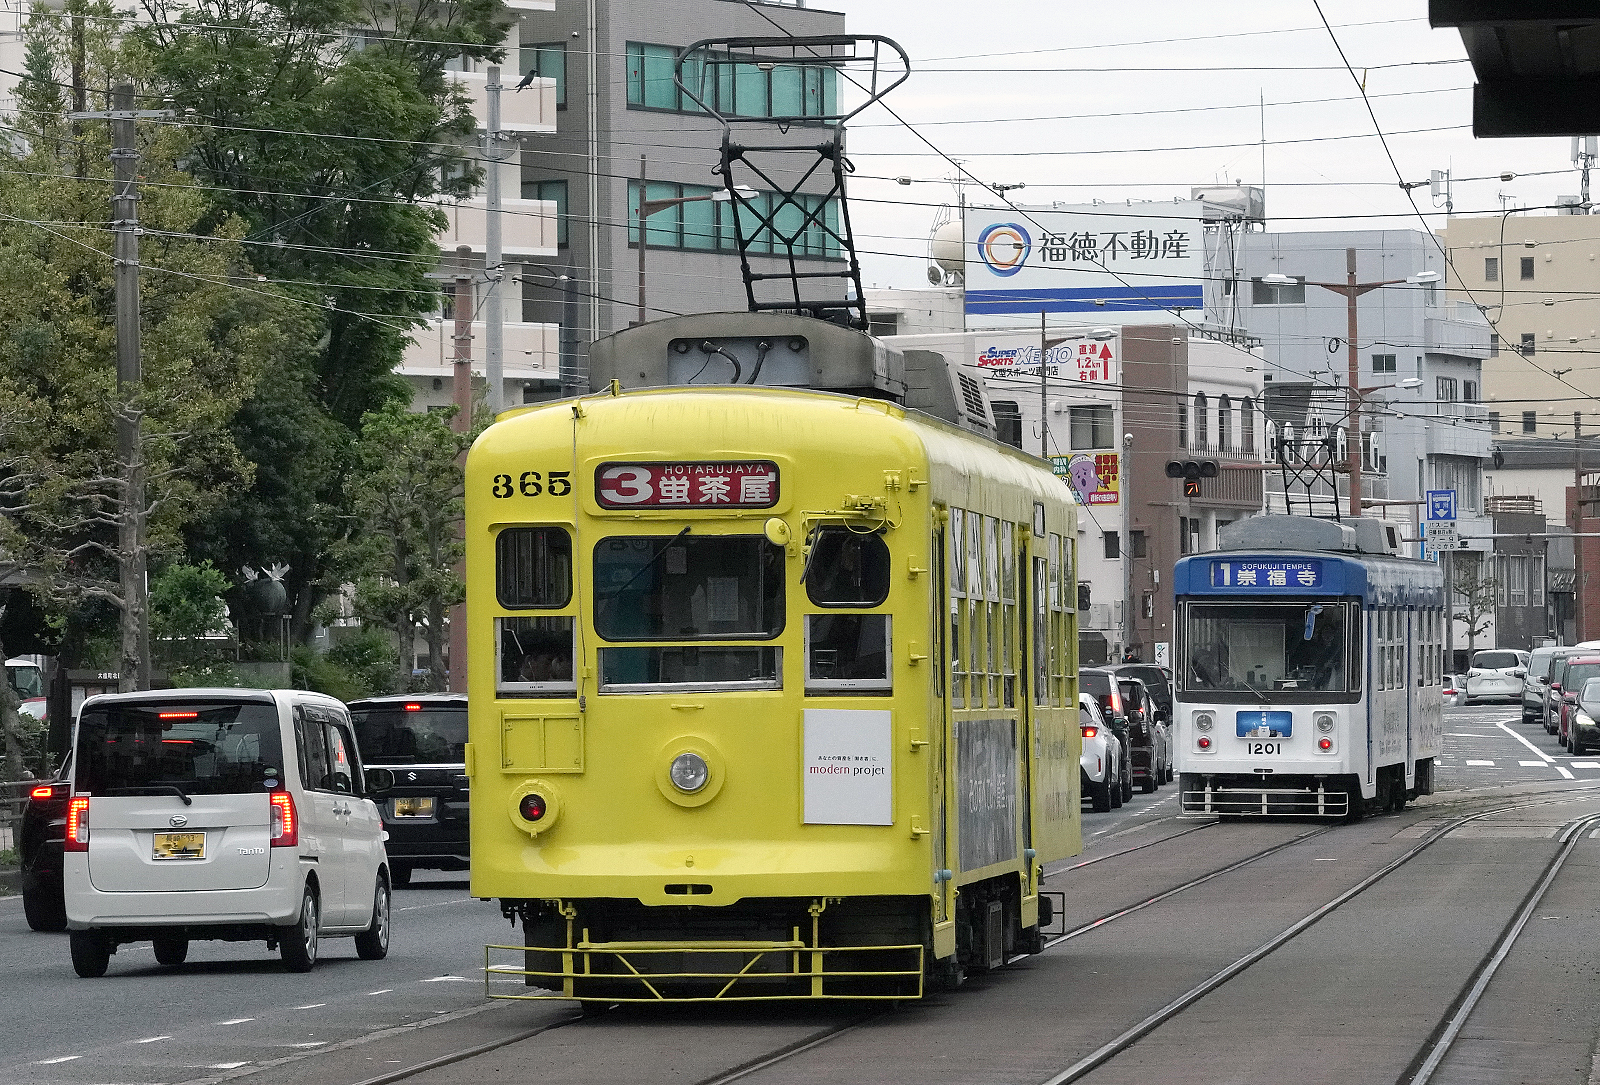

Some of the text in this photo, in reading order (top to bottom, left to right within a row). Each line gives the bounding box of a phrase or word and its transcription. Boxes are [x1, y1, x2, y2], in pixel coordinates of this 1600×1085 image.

[1037, 229, 1191, 262] 福徳不動産
[1078, 344, 1098, 355] 直進
[977, 355, 1014, 367] SPORTS
[1076, 357, 1101, 369] 1.2km
[1079, 370, 1098, 381] 右側
[664, 464, 765, 475] HOTARUJAYA
[492, 470, 572, 498] 365
[600, 466, 654, 504] 3
[658, 471, 776, 504] 蛍茶屋
[1220, 563, 1231, 586] 1
[1236, 569, 1317, 587] 崇福寺
[1248, 743, 1281, 755] 1201
[809, 764, 885, 776] modern projet
